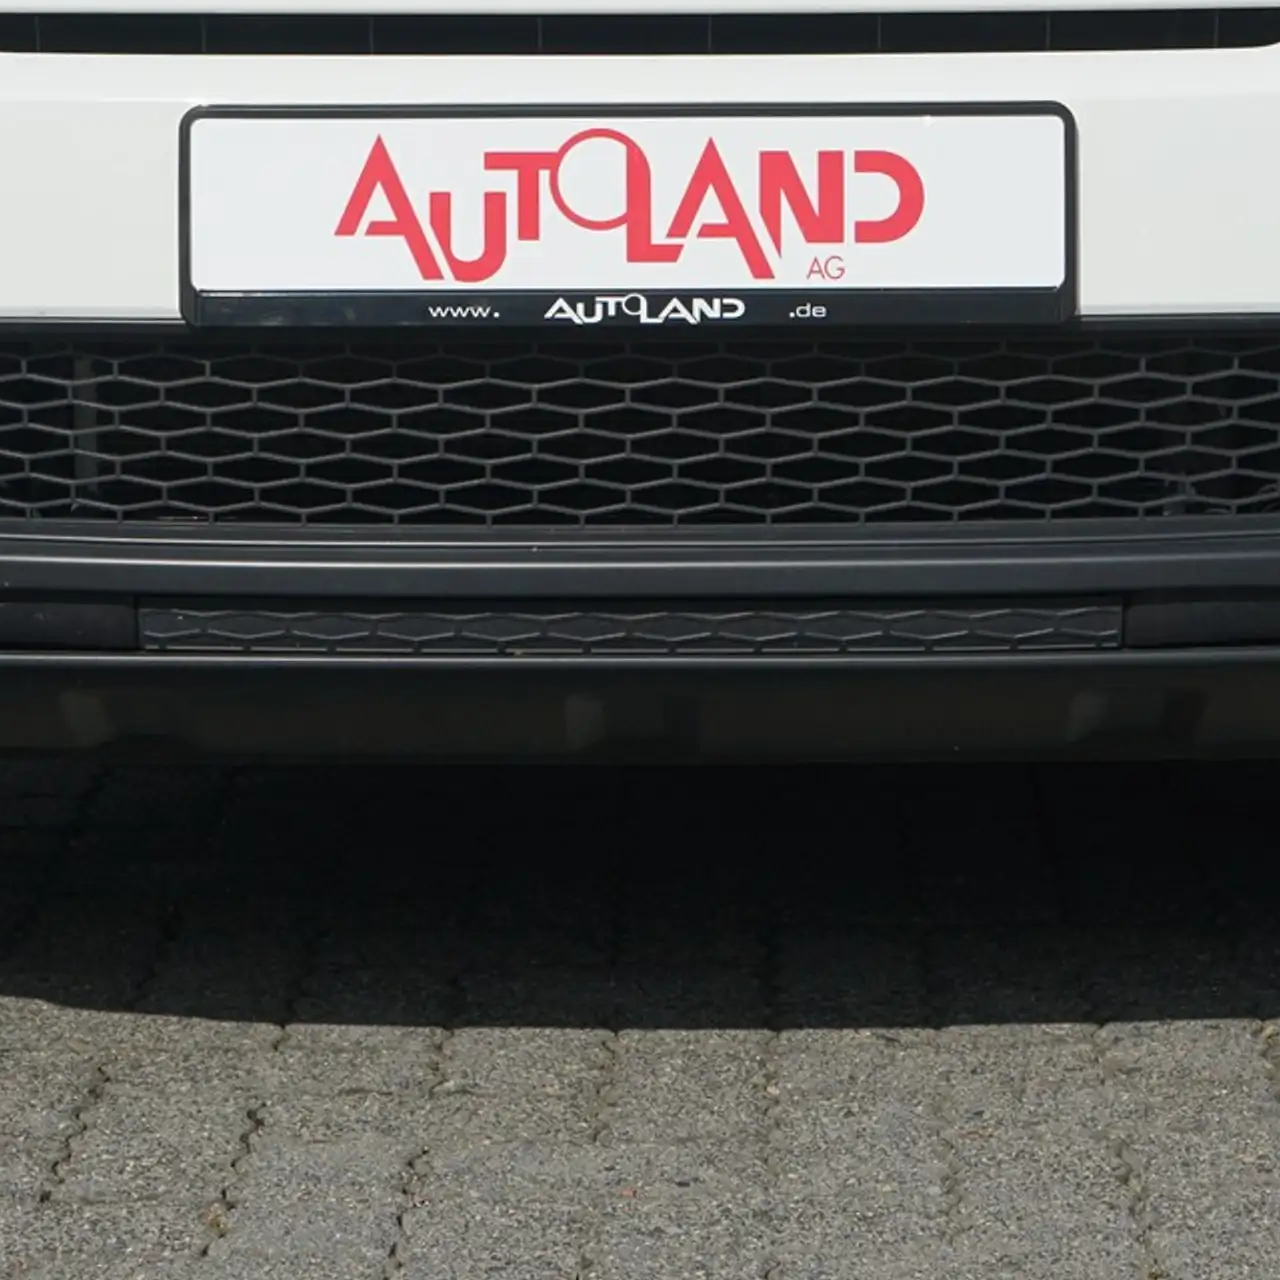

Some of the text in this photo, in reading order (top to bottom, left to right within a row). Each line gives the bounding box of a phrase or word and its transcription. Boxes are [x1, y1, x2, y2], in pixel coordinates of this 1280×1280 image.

[334, 128, 925, 283] AUTOLAND
[805, 255, 846, 281] AG
[428, 292, 827, 325] www. AUTOLAND .de
